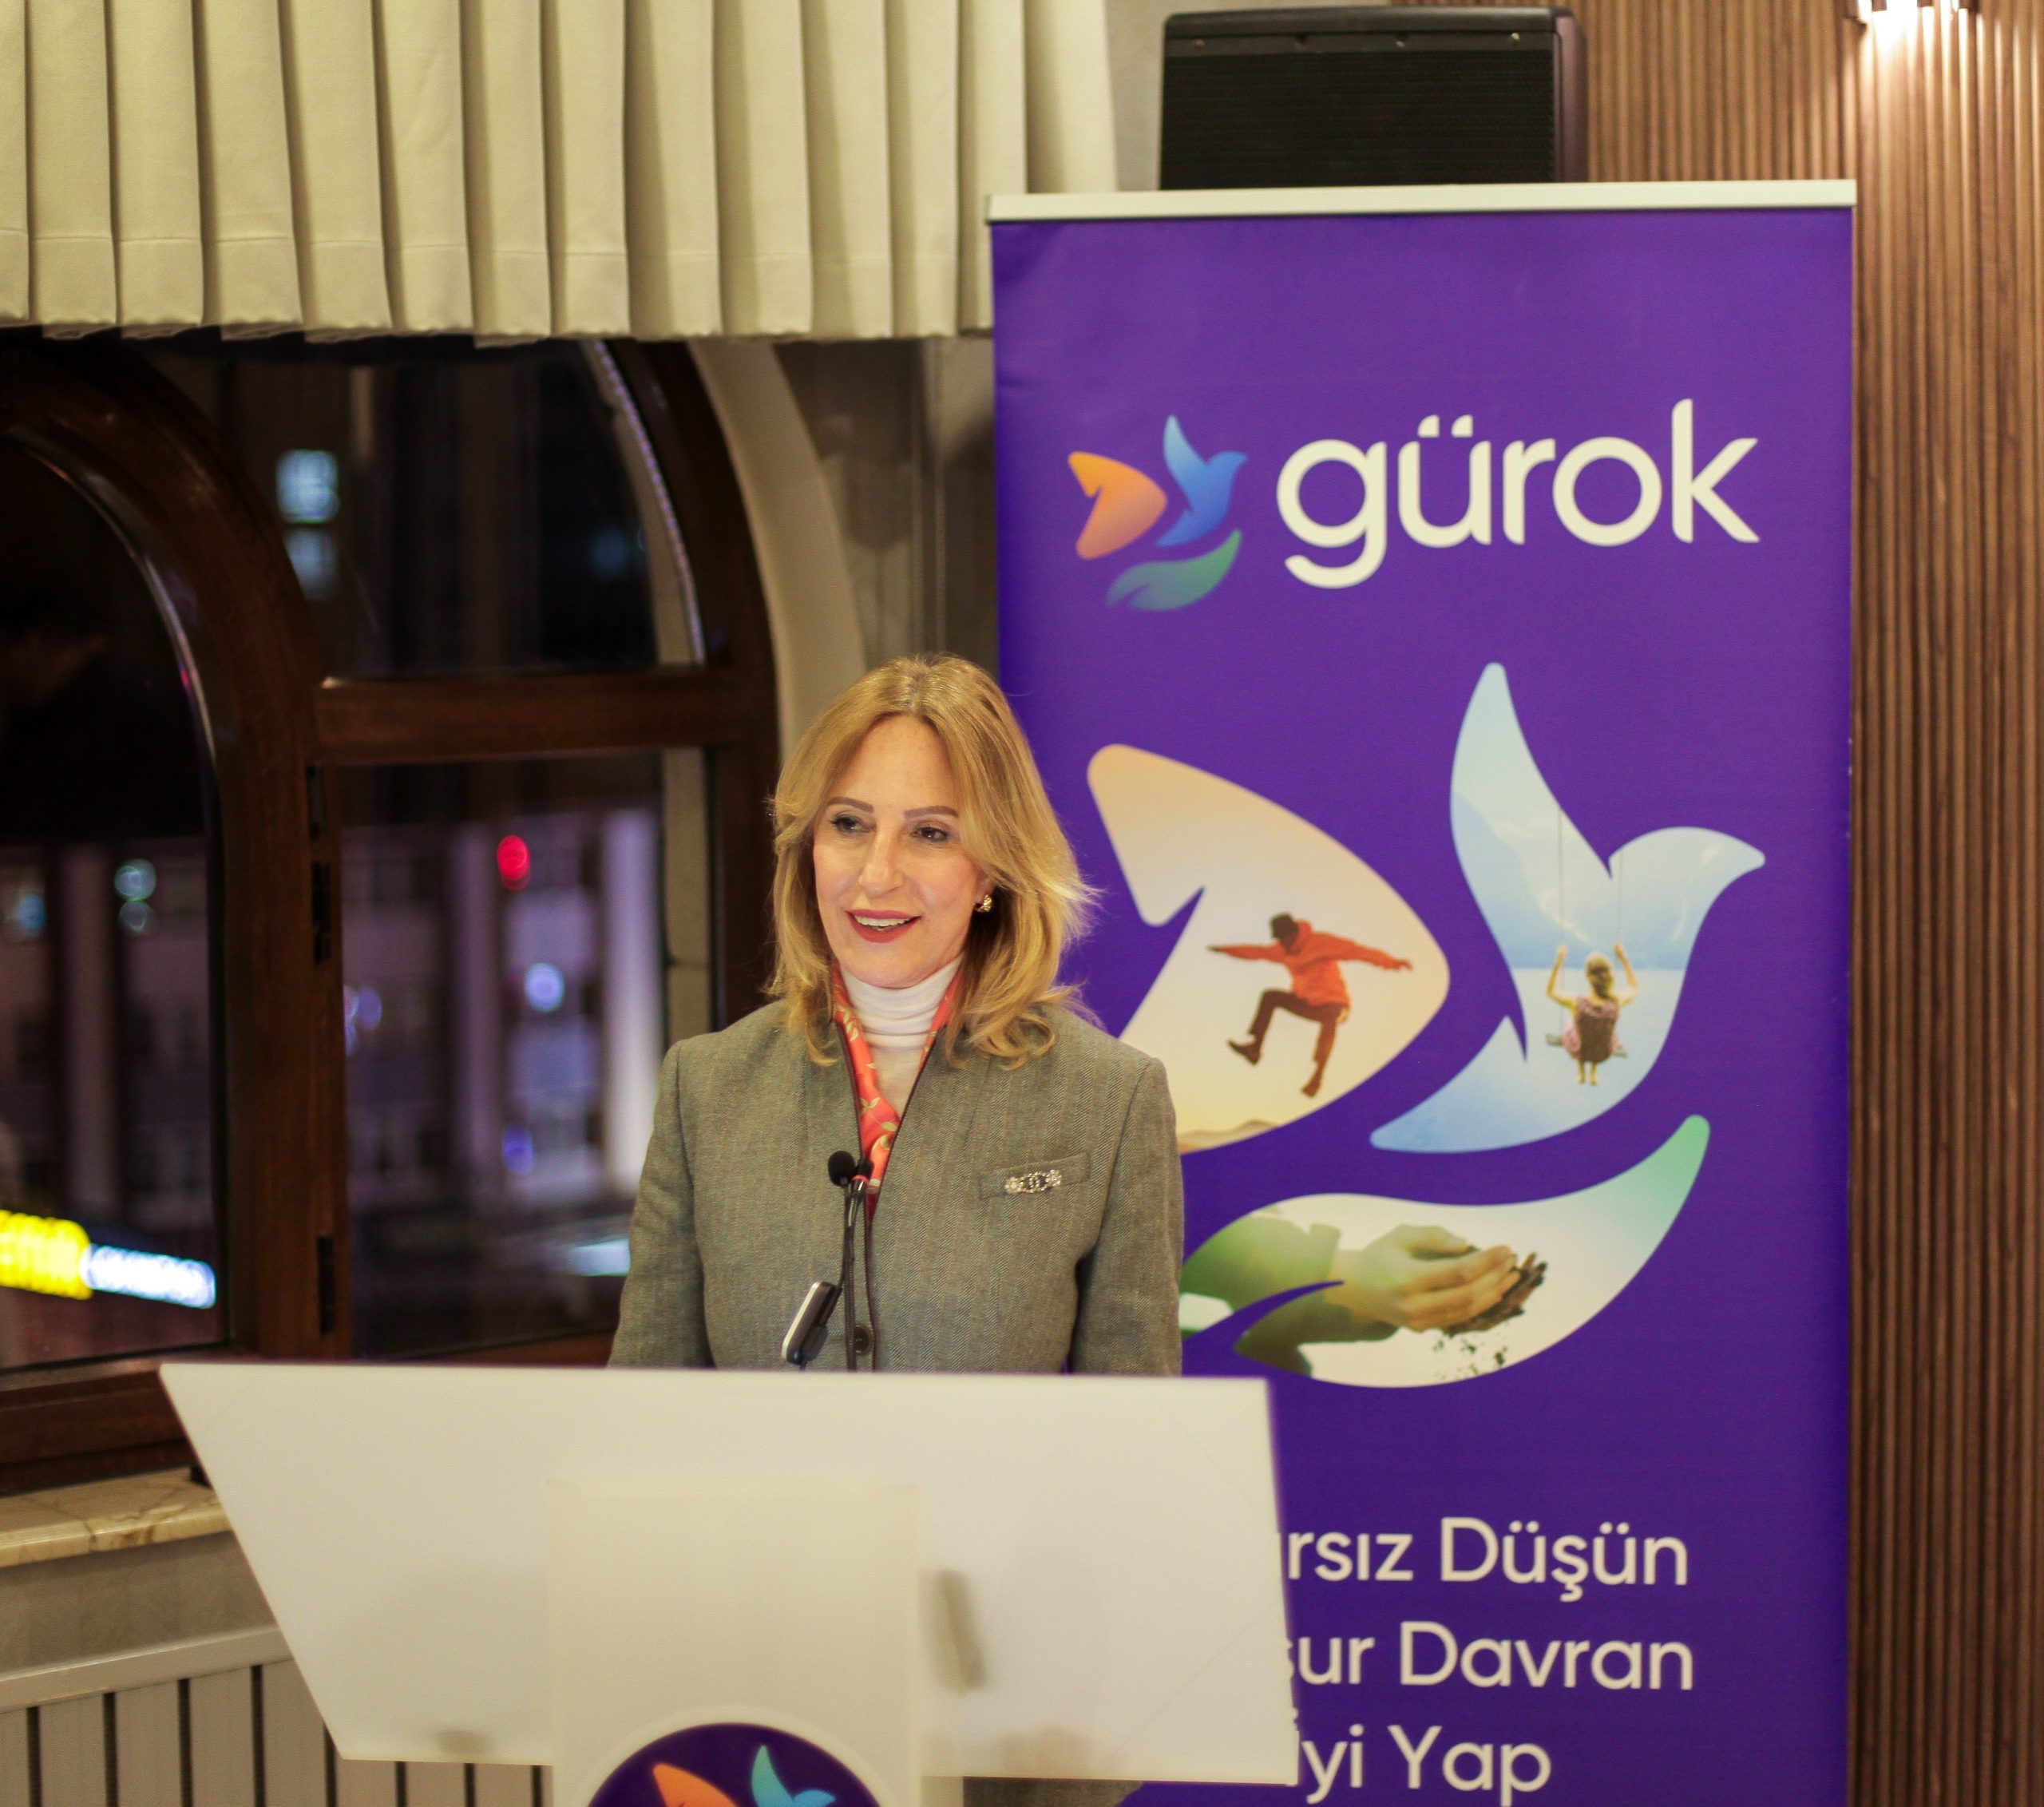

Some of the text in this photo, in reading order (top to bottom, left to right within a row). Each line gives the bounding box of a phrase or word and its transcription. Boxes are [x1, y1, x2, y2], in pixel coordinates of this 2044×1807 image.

[1276, 398, 1761, 589] gürok
[1278, 1516, 1688, 1603] rsız Düşün
[1287, 1621, 1693, 1690] ur Davran
[1293, 1707, 1552, 1807] yi Yap
